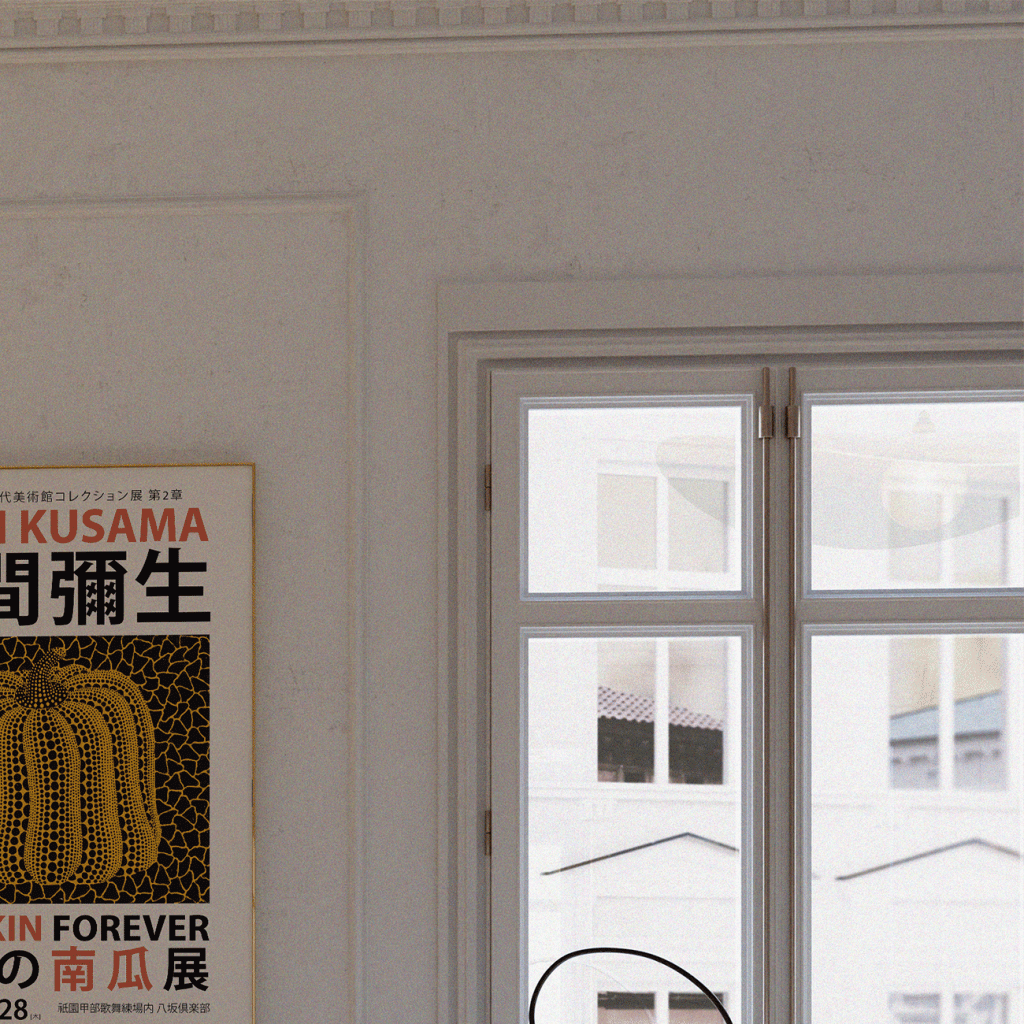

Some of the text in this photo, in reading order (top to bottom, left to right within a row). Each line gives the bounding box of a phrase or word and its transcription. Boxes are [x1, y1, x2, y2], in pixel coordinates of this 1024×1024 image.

[148, 488, 183, 502] 第2章
[21, 508, 209, 544] KUSAMA
[54, 915, 209, 941] FOREVER
